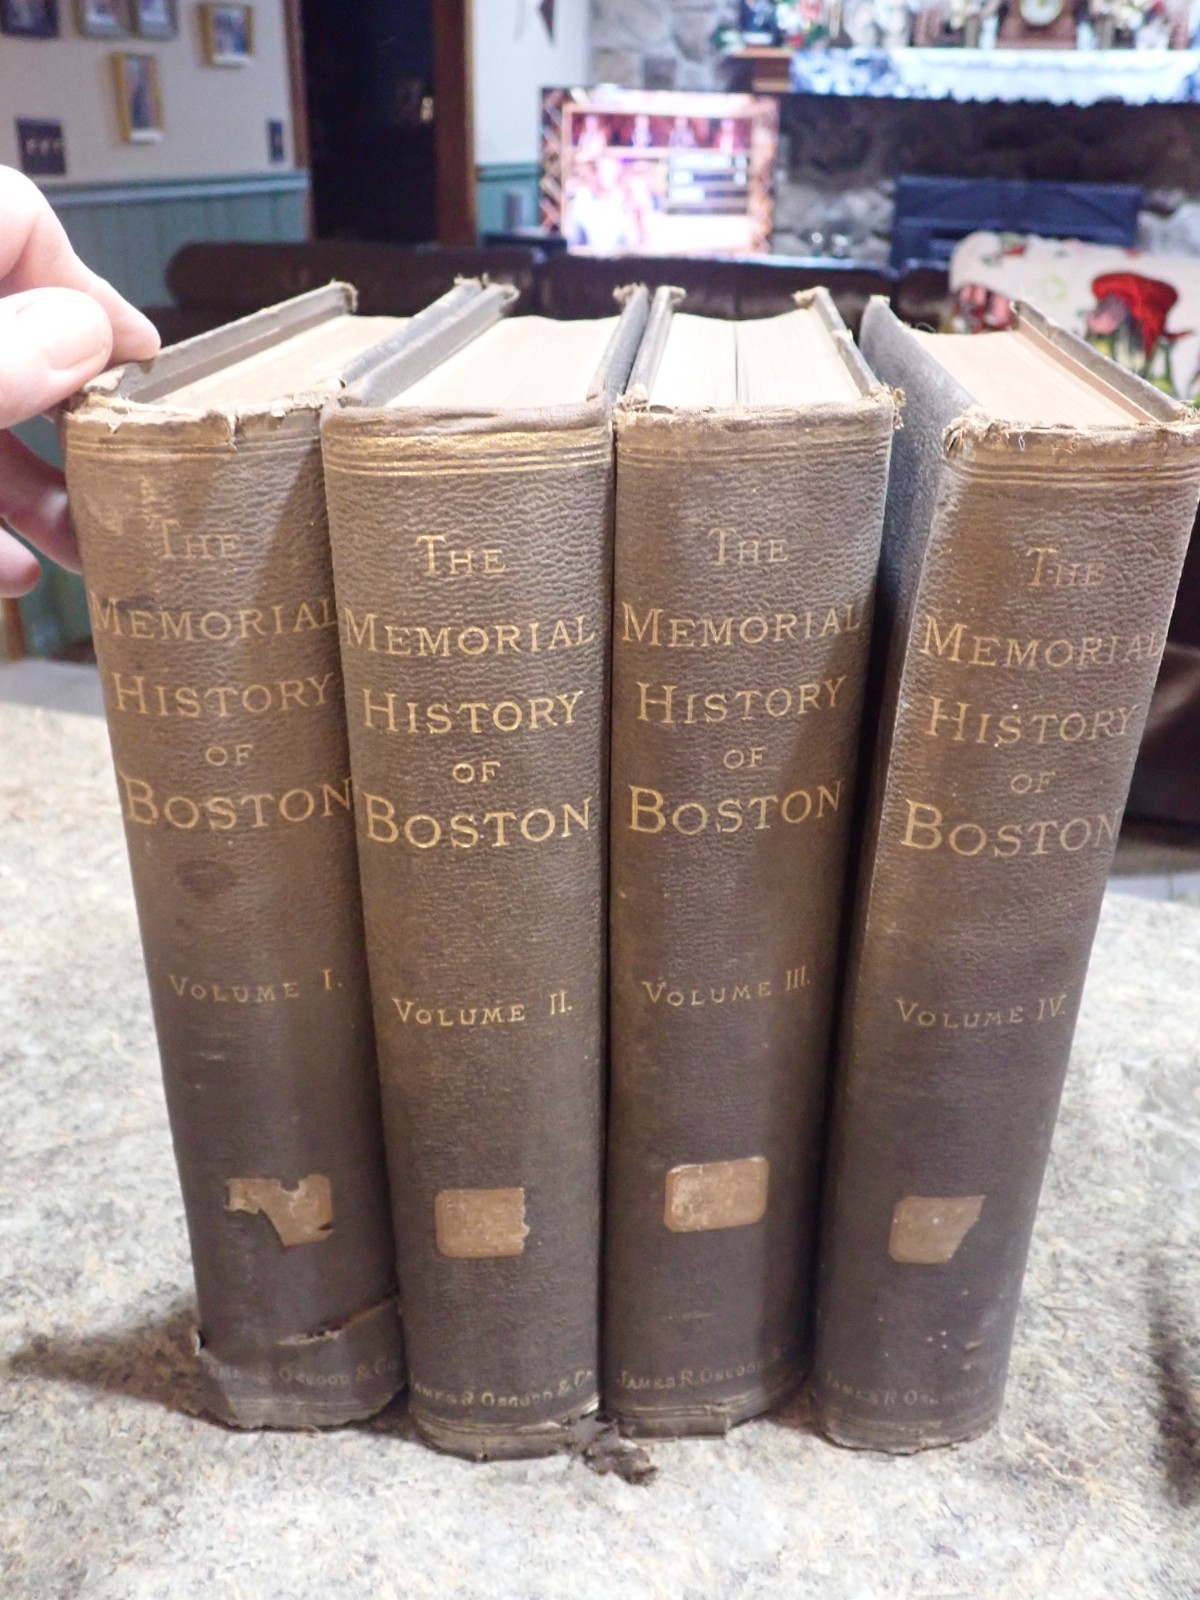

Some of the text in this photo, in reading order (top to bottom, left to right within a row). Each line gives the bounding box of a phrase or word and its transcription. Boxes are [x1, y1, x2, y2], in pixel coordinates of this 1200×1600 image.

[344, 608, 595, 657] MEMORIAL
[622, 602, 861, 648] MEMORIAL
[920, 614, 1162, 668] MEMORIAL
[112, 672, 333, 717] HISTORY
[363, 688, 583, 734] HISTORY
[636, 677, 847, 723] HISTORY
[924, 697, 1138, 744] HISTORY
[205, 744, 252, 766] OF
[453, 761, 500, 783] OF
[723, 747, 767, 770] OF
[1011, 772, 1056, 794] OF
[364, 793, 592, 848] BOSTON
[628, 780, 844, 836] BOSTON
[901, 798, 1122, 857] BOSTON
